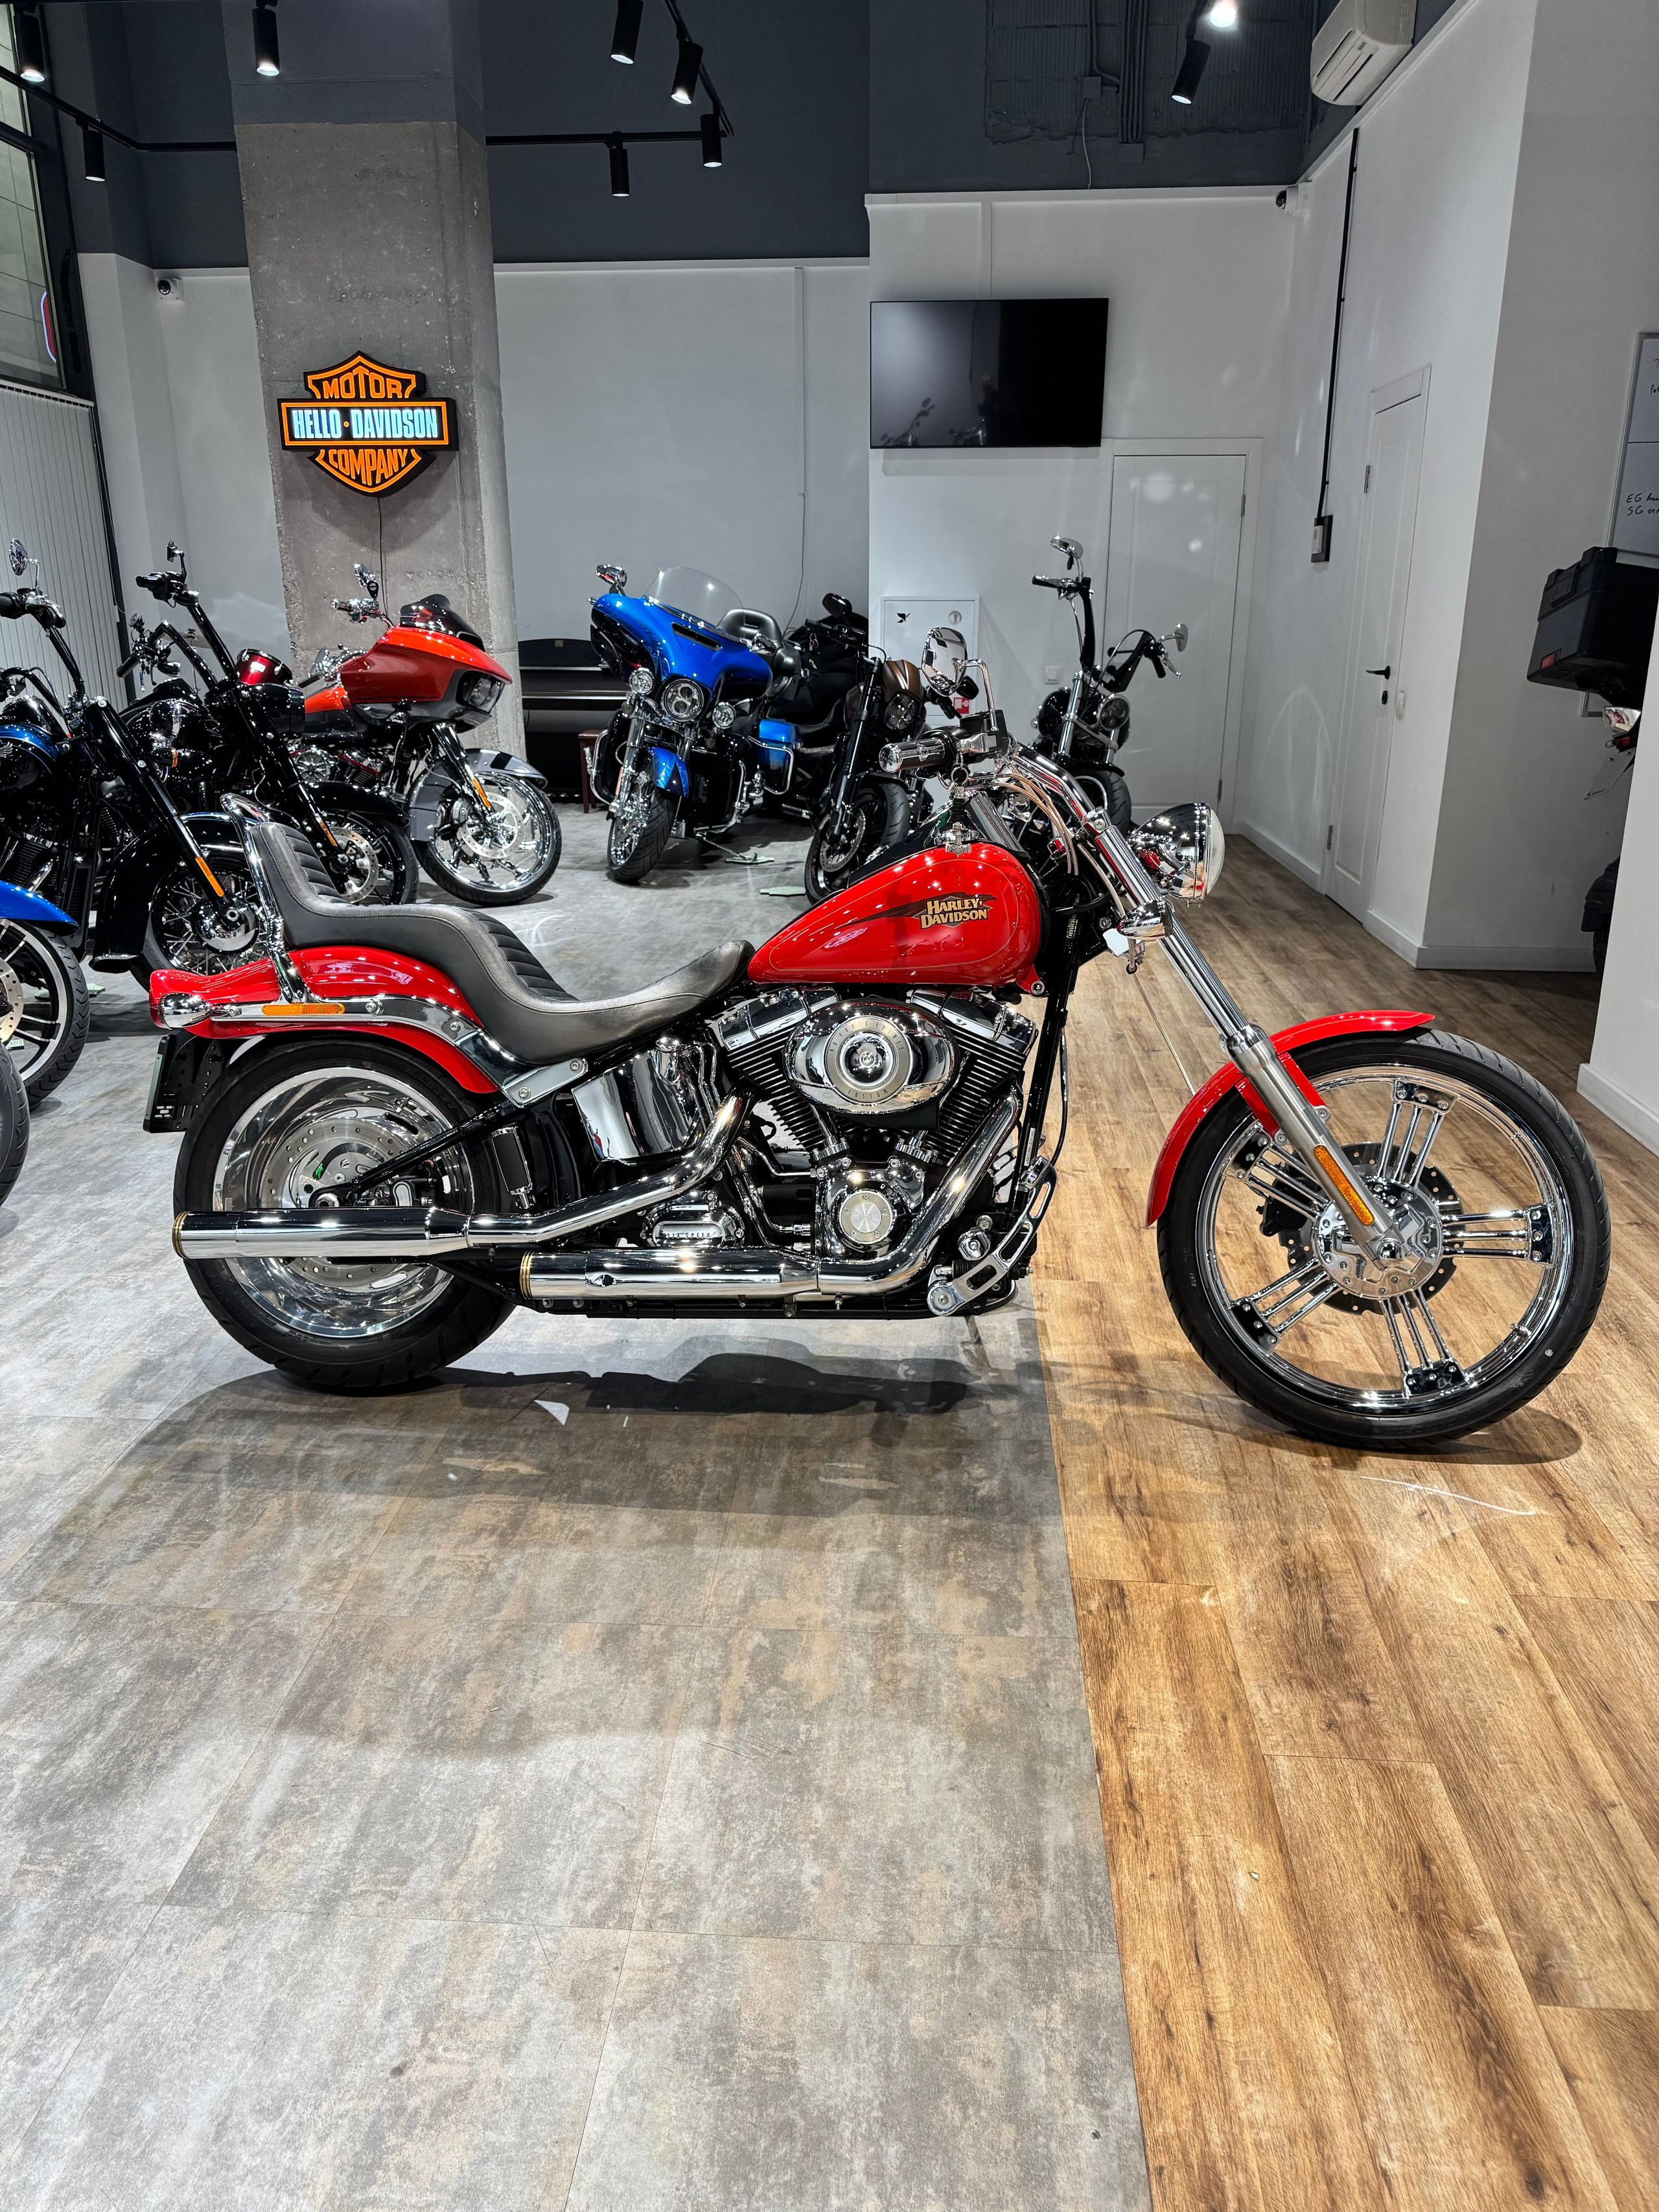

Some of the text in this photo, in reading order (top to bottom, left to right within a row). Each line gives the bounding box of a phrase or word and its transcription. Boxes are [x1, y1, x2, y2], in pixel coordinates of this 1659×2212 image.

[322, 366, 402, 399] MOTOR
[292, 409, 439, 439] HELLO DAVIDSON
[328, 448, 408, 486] COMPANY
[920, 909, 988, 929] DAVIDSON
[848, 1089, 888, 1099] CUSTOM
